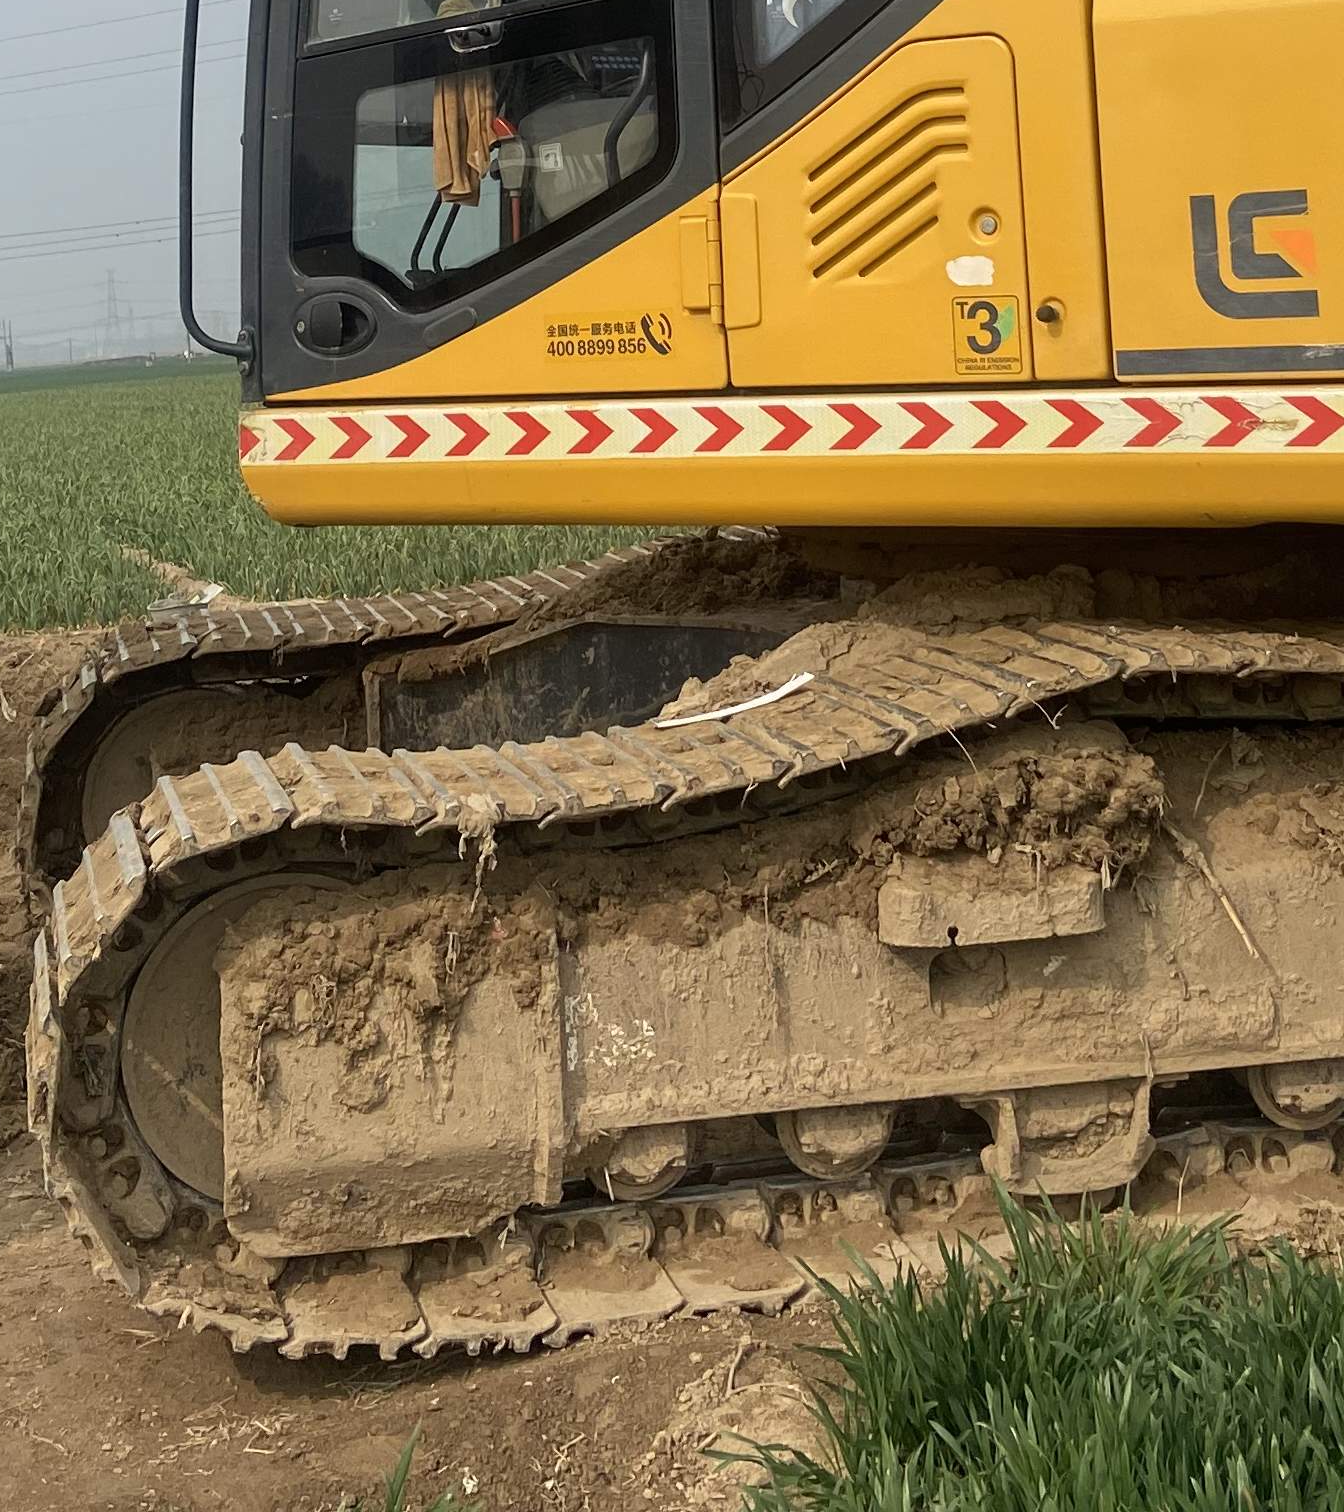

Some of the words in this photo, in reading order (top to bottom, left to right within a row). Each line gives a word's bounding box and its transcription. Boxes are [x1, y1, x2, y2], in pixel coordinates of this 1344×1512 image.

[547, 322, 636, 338] 全国统一服务电话
[547, 341, 574, 356] 400
[578, 339, 614, 356] 8899
[618, 338, 647, 354] 856
